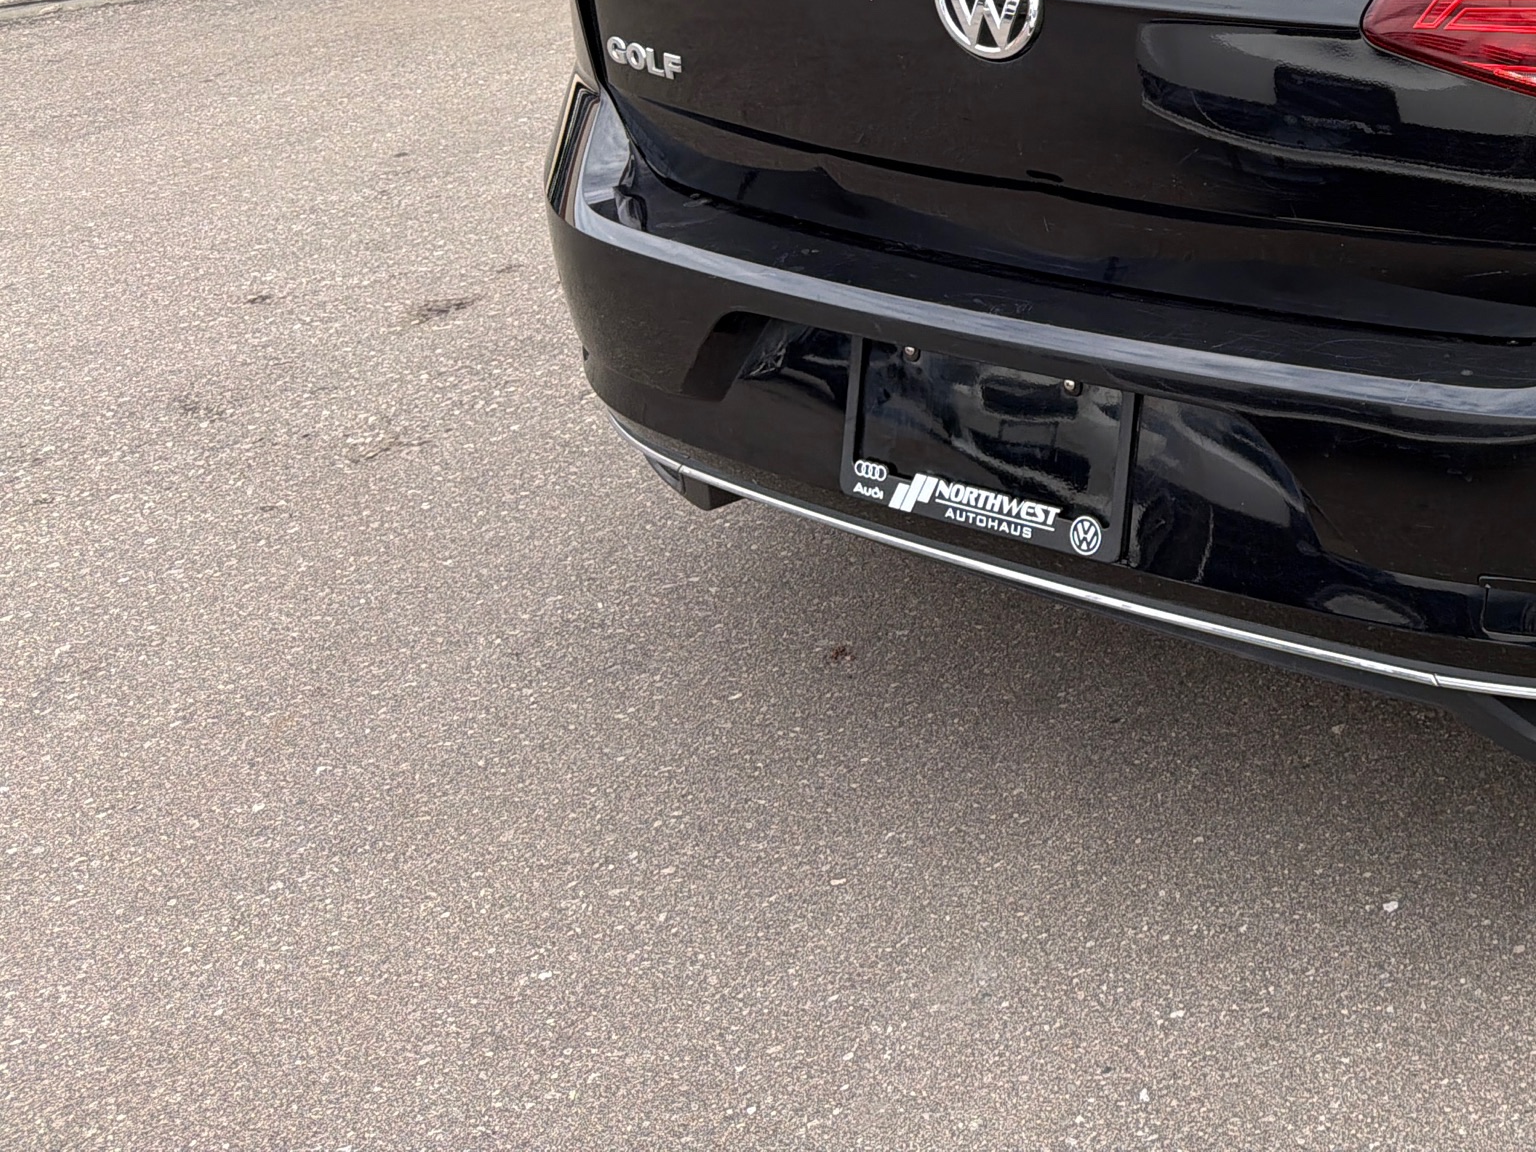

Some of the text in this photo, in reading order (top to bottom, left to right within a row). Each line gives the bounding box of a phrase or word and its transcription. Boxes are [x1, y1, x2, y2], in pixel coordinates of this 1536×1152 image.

[606, 35, 683, 80] GOLF
[852, 482, 884, 500] Audi
[934, 482, 1061, 526] NORTHWEST
[944, 507, 1033, 539] AUTOHAUS
